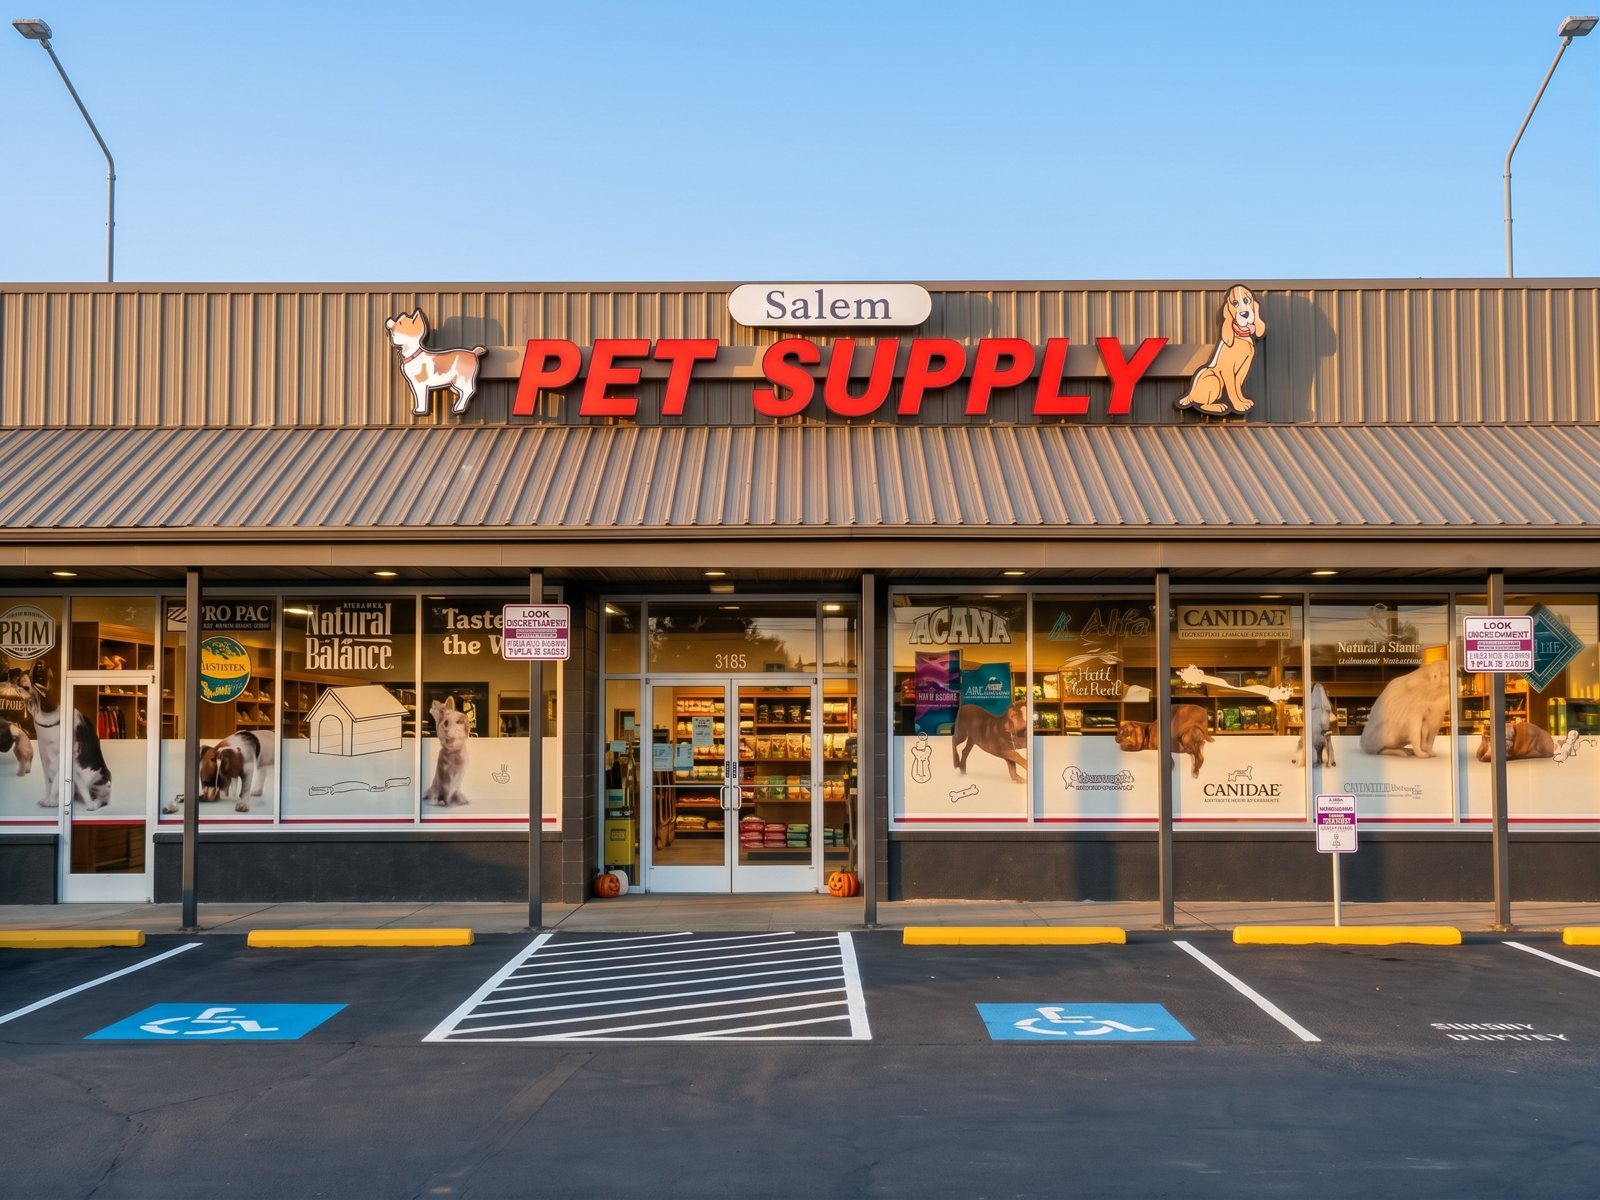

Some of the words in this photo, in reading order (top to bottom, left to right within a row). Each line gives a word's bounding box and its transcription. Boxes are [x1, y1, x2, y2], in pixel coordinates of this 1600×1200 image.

[764, 289, 893, 320] Salem
[512, 338, 720, 417] PET
[752, 337, 1170, 417] SUPPLY
[235, 605, 270, 621] PAC
[304, 602, 393, 636] Natural
[522, 610, 550, 618] LOOK
[0, 621, 50, 645] PRIM
[908, 606, 1012, 645] ACANA
[1483, 622, 1512, 630] LOOK
[443, 634, 481, 655] the
[714, 653, 747, 670] 3185
[1203, 783, 1282, 797] CANIDAE
